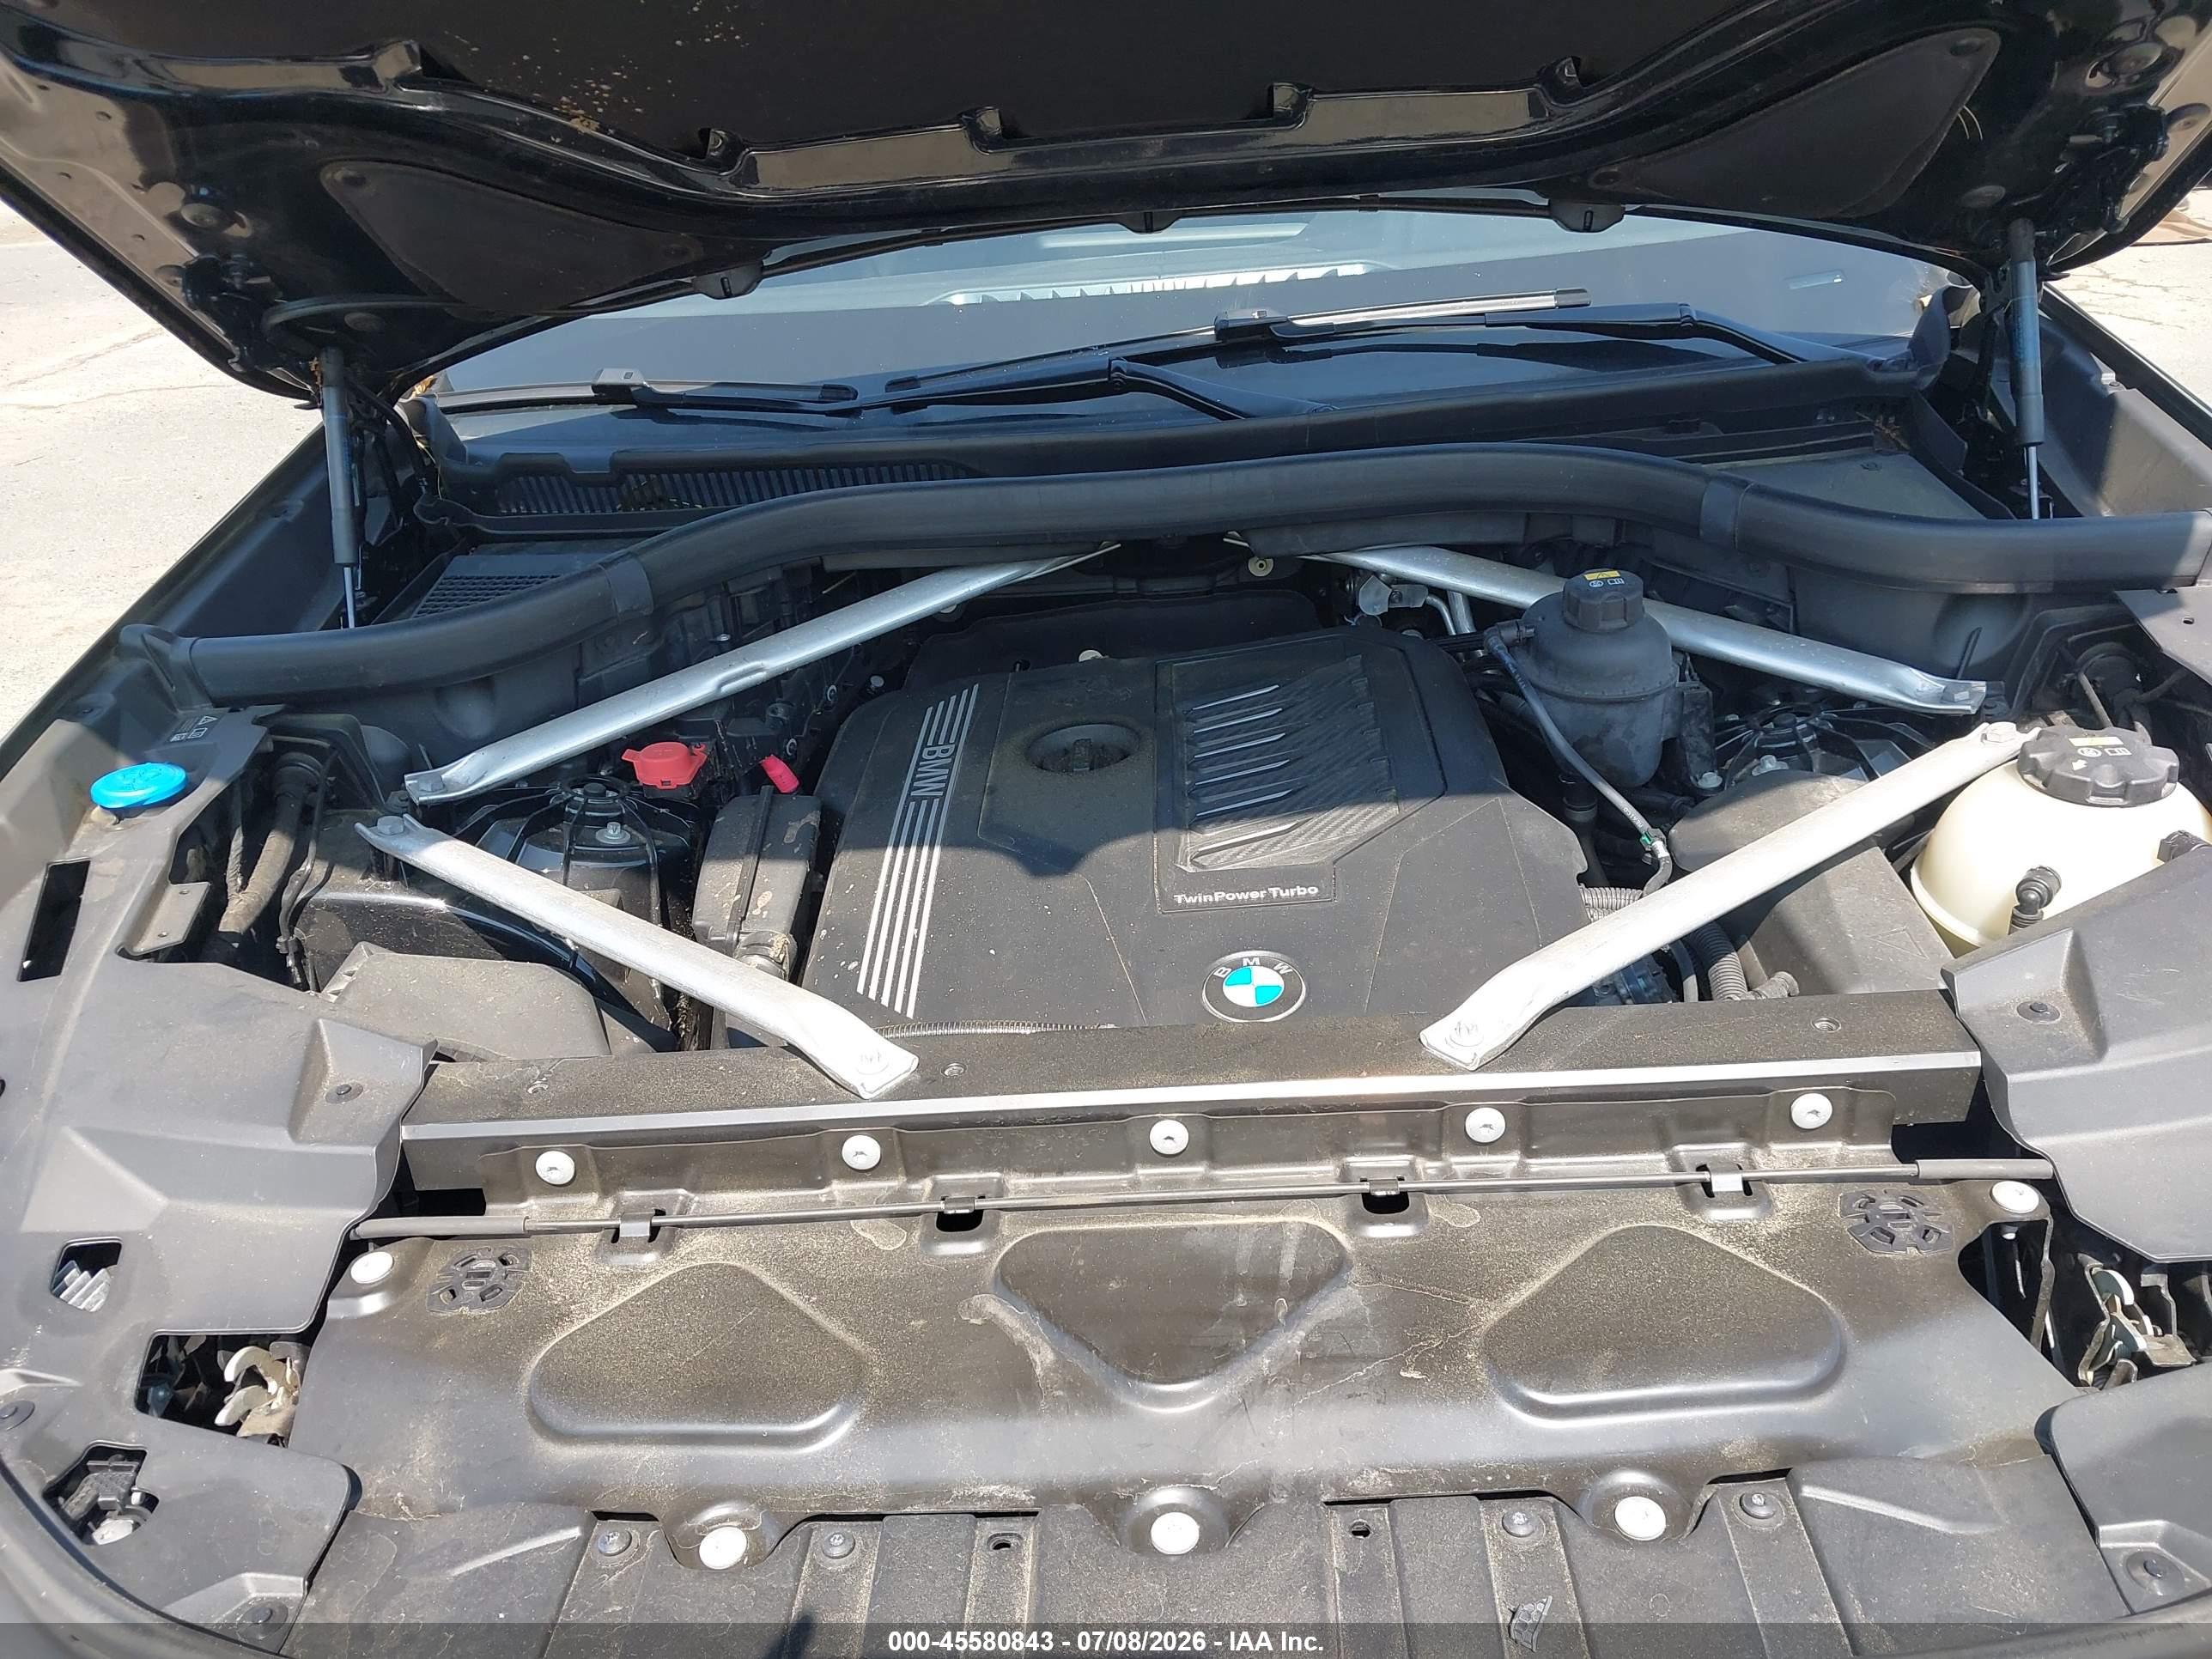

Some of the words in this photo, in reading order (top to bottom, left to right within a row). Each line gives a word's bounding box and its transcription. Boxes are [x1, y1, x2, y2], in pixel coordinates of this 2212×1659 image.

[910, 744, 956, 796] BMW
[1267, 885, 1319, 899] Turbo
[1213, 957, 1293, 978] BMW
